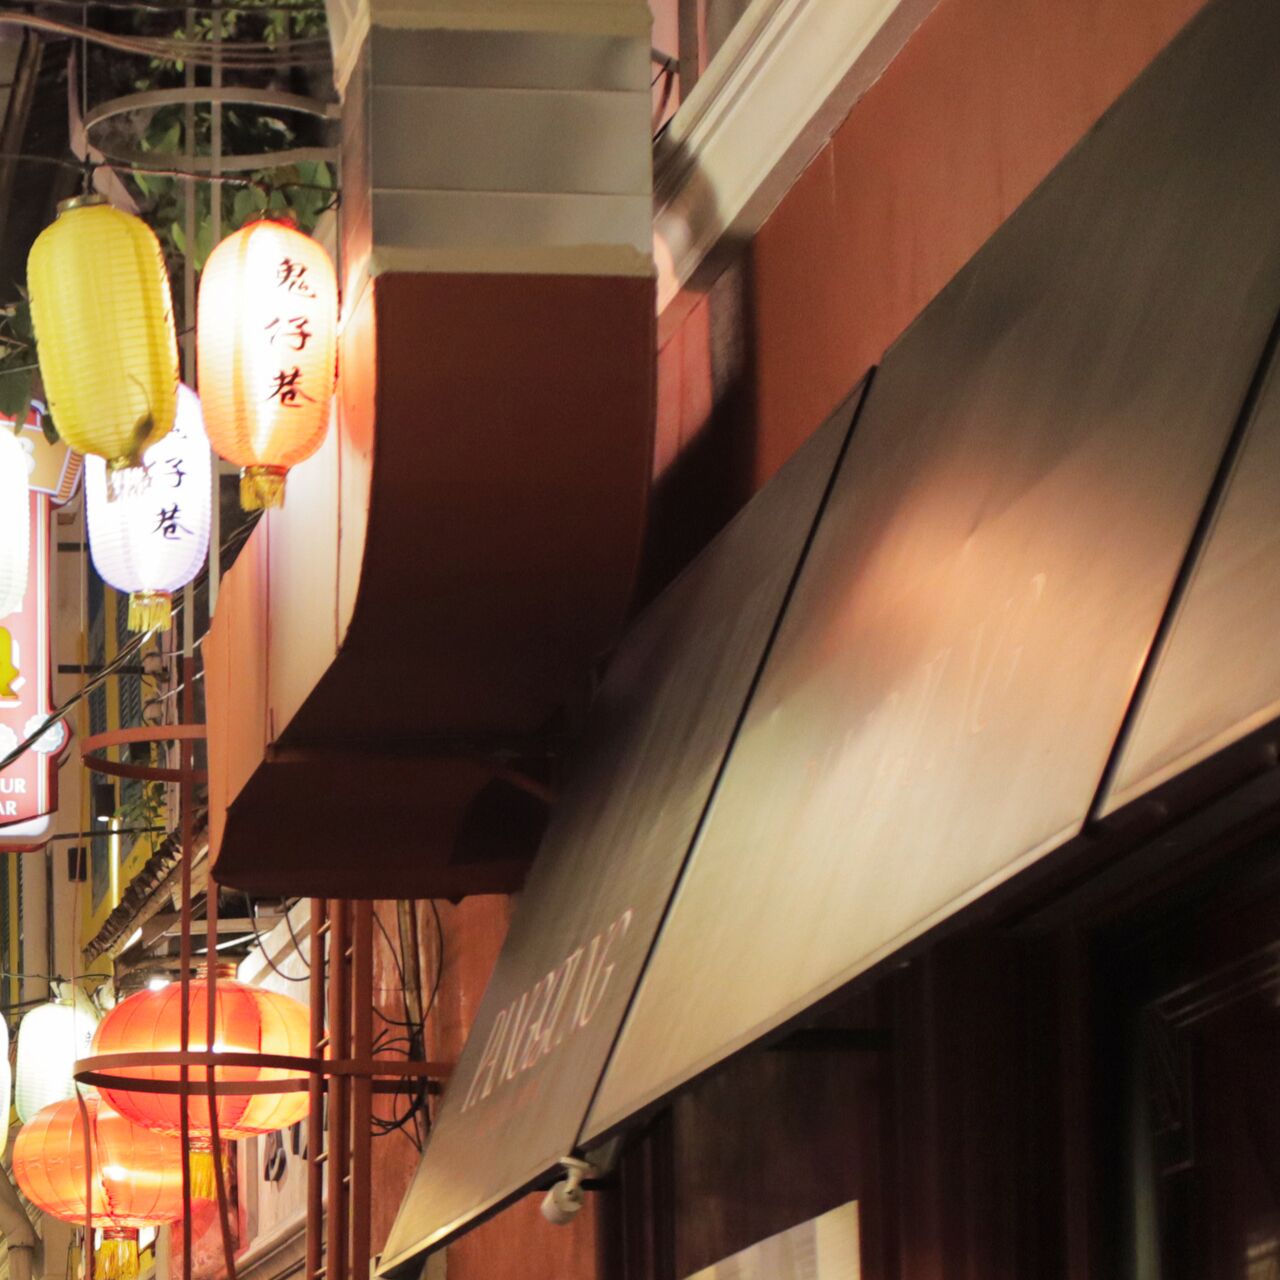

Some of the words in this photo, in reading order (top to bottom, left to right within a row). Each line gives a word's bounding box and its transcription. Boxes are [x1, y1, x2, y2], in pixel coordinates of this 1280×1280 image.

[263, 256, 318, 409] 鬼仔巷
[145, 426, 195, 541] 仔巷
